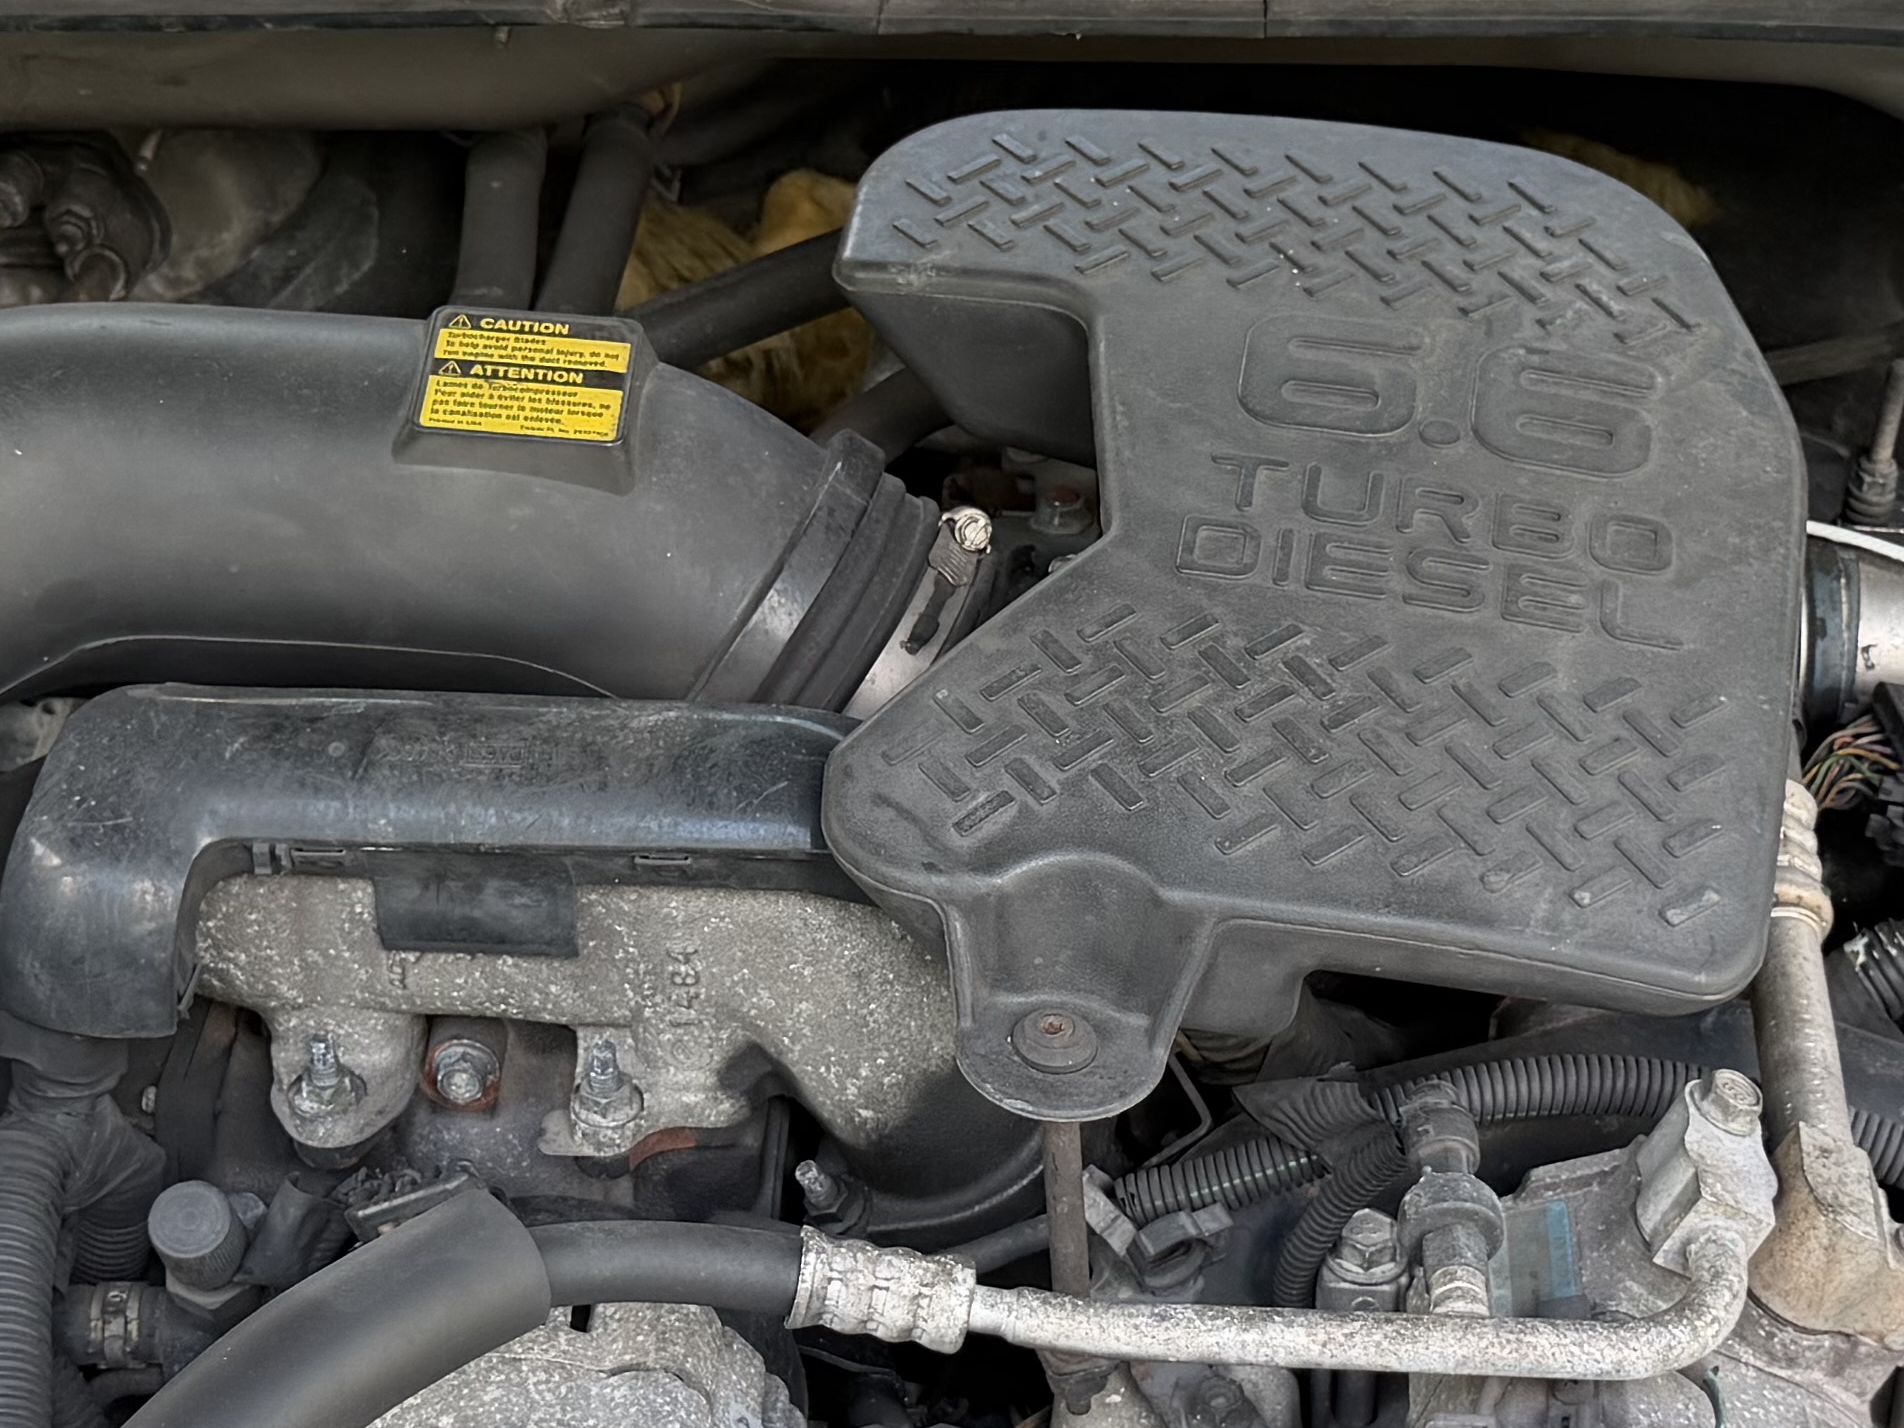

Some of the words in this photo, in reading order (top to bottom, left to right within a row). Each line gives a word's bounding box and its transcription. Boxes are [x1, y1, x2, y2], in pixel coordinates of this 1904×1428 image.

[480, 318, 570, 335] CAUTION
[459, 341, 479, 349] help
[482, 343, 509, 351] avoid
[512, 345, 554, 355] personal
[557, 349, 585, 358] injury,
[462, 351, 494, 359] engine
[498, 352, 518, 360] with
[563, 360, 607, 368] removed.
[470, 364, 584, 384] ATTENTION
[435, 388, 457, 397] Pour
[546, 398, 595, 409] blessures,
[1236, 314, 1670, 479] 6.6
[443, 409, 502, 419] canalisation
[453, 399, 475, 407] faire
[479, 401, 513, 410] tourner
[529, 406, 564, 414] moteur
[567, 409, 603, 418] lorsque
[1211, 453, 1678, 581] TURBO
[1175, 513, 1684, 650] DIESEL
